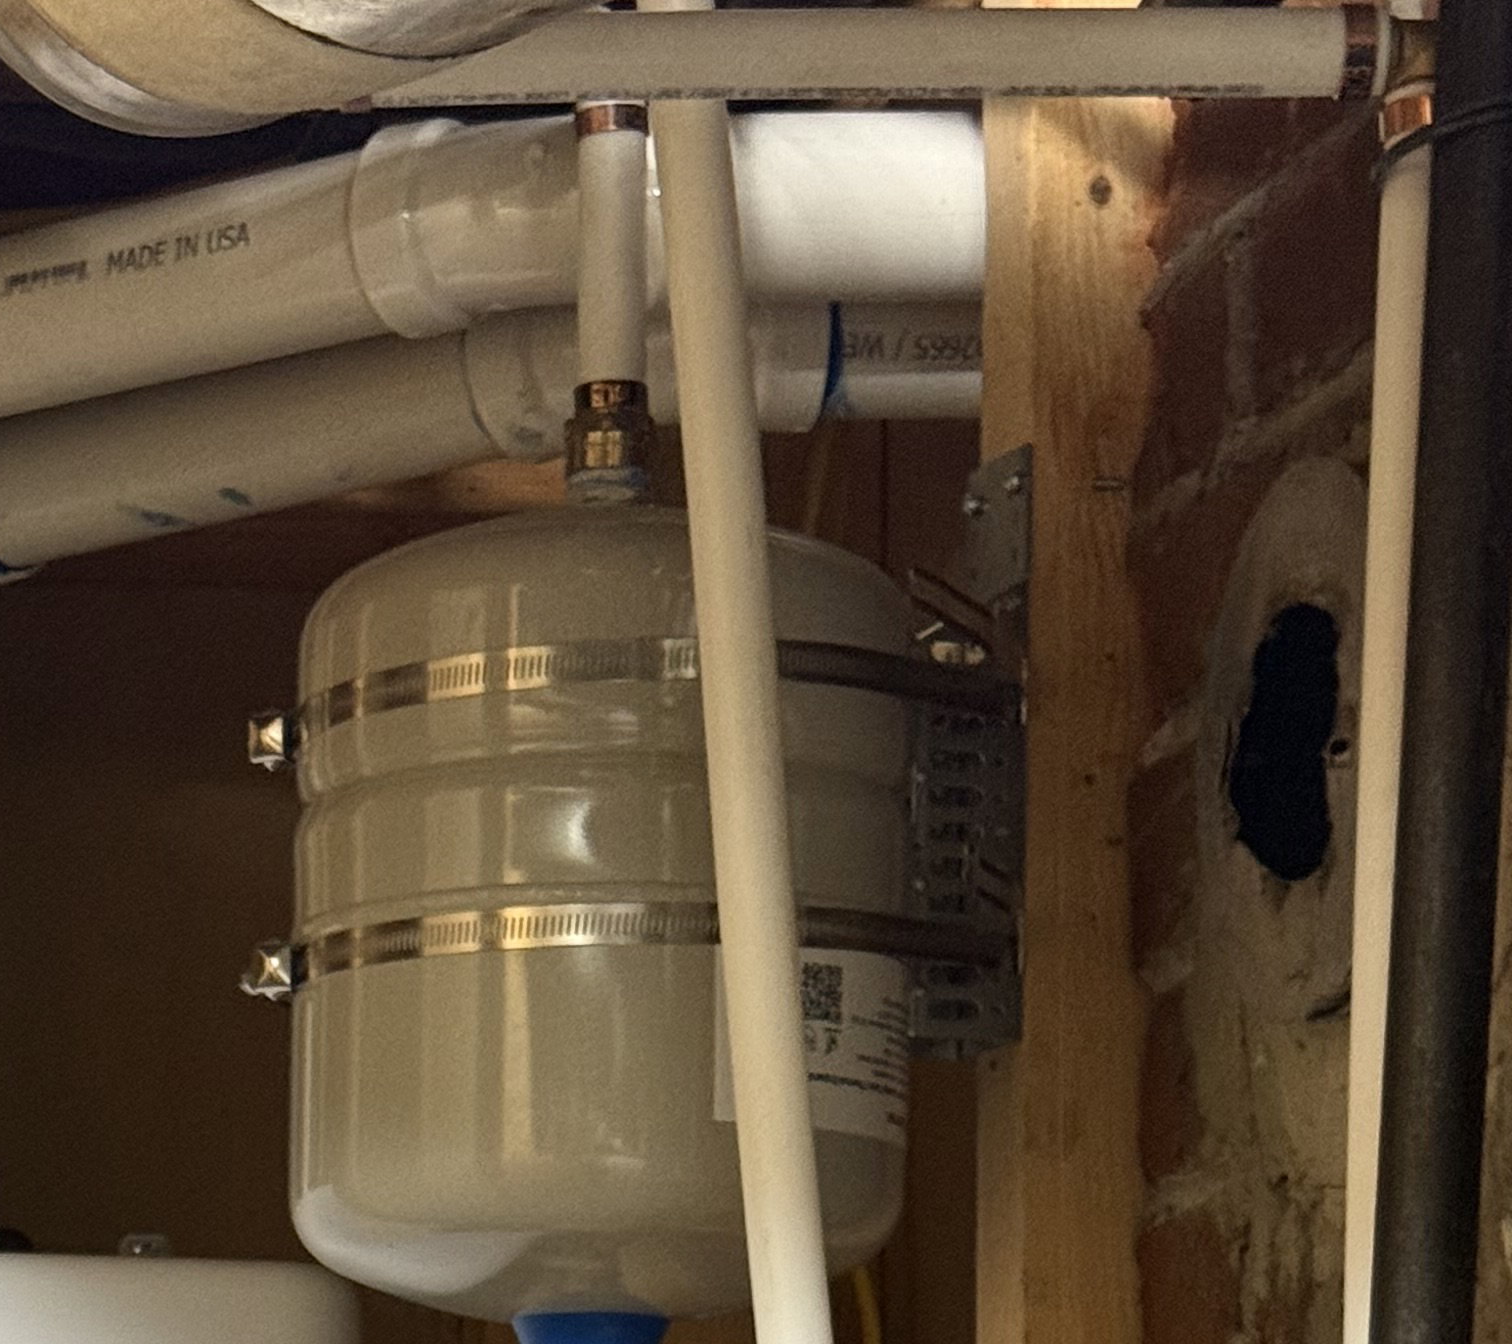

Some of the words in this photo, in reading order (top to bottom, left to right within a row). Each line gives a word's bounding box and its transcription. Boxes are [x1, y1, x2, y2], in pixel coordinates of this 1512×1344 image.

[105, 240, 168, 276] MADE
[174, 234, 199, 263] IN
[207, 221, 250, 256] USA
